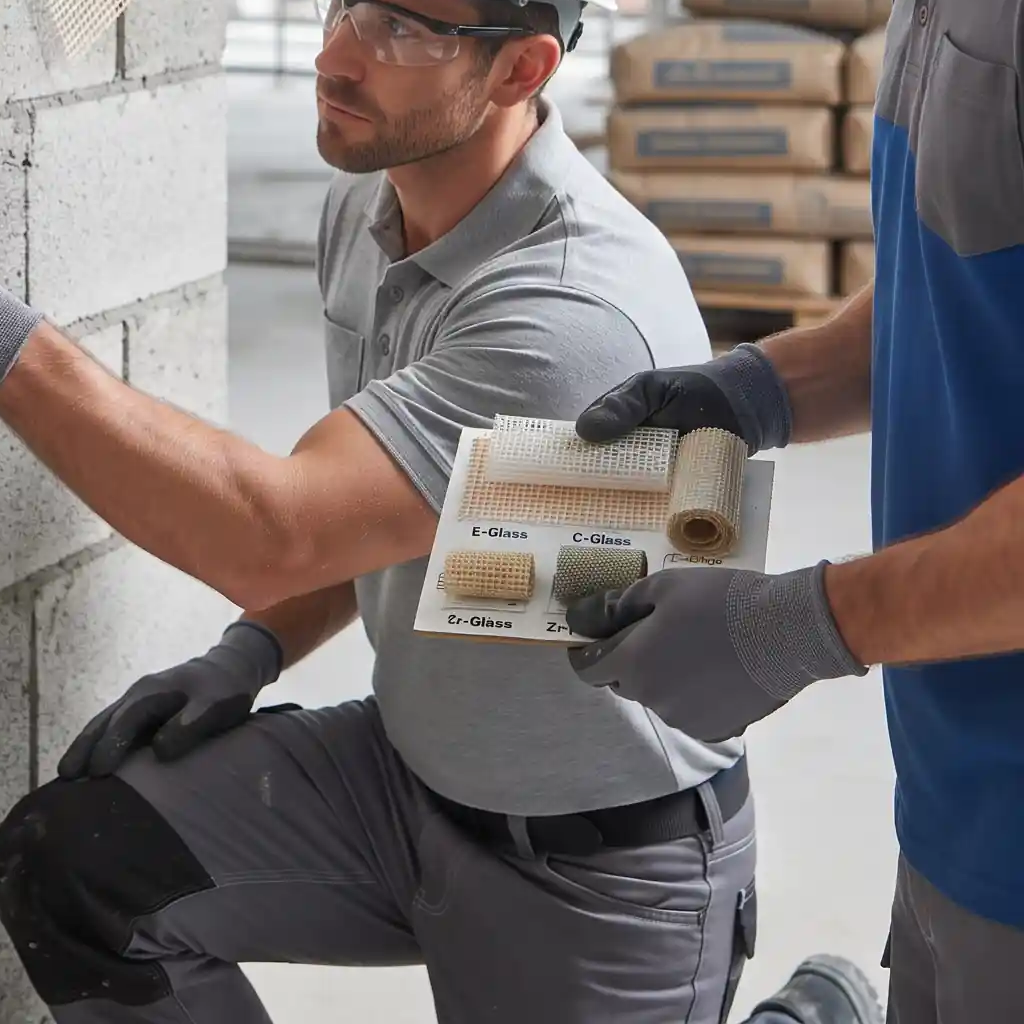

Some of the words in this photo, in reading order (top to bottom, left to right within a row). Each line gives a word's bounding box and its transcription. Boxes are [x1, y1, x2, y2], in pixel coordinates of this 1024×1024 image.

[471, 526, 528, 539] E-Glass
[572, 532, 631, 546] C-Glass
[546, 622, 573, 636] Zr-
